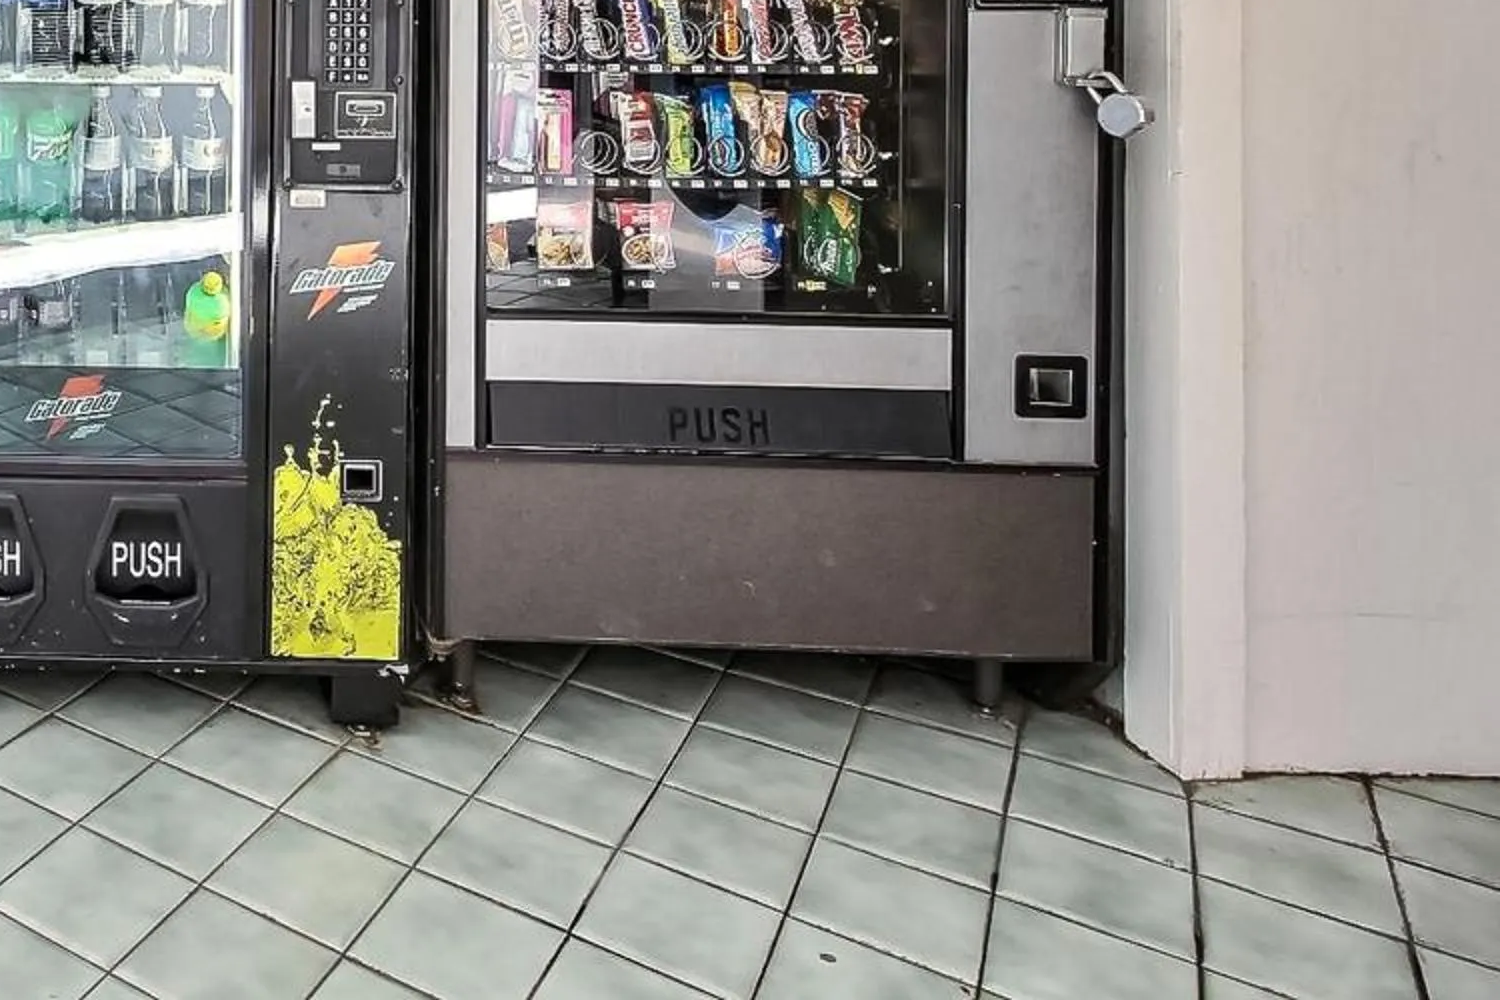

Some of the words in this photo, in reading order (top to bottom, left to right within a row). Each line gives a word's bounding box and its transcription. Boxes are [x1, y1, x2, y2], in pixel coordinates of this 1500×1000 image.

[27, 391, 121, 421] Gatorade
[667, 405, 771, 446] PUSH
[111, 541, 182, 578] PUSH
